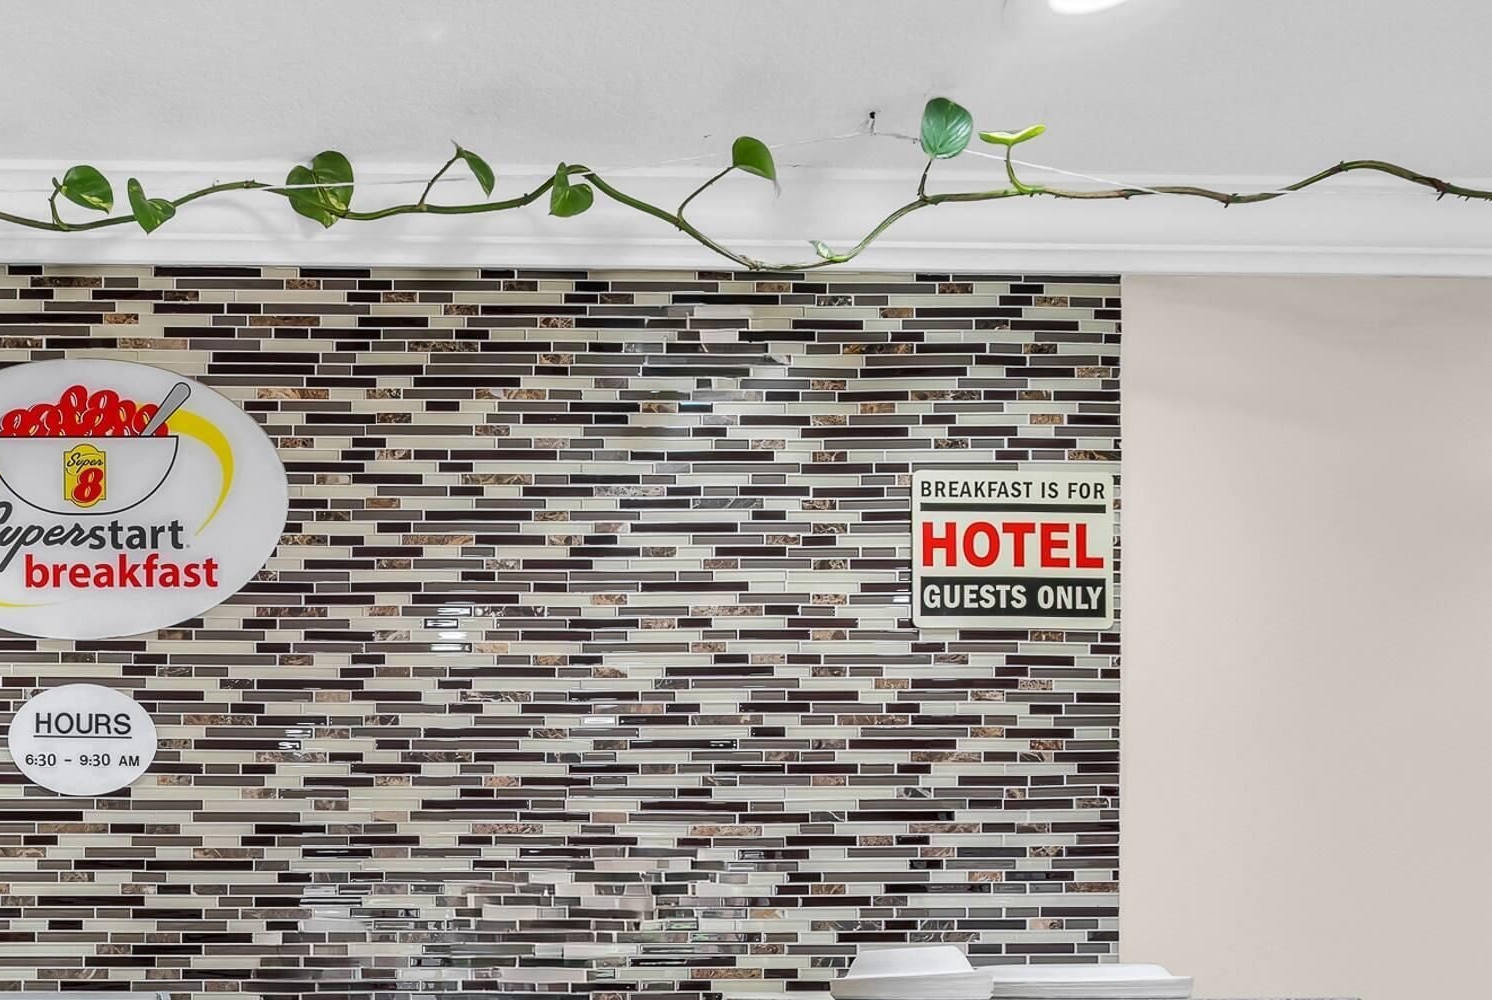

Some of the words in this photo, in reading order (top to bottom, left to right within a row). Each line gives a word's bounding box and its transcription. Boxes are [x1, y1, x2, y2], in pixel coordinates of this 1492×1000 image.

[66, 452, 104, 473] Super
[72, 467, 104, 503] 8
[920, 480, 1033, 499] BREAKFAST
[1040, 481, 1059, 499] IS
[1067, 482, 1106, 500] FOR
[921, 521, 1105, 569] HOTEL
[24, 553, 219, 589] breakfast
[922, 583, 1028, 610] GUESTS
[1037, 585, 1103, 610] ONLY
[35, 712, 132, 735] HOURS
[25, 753, 57, 767] 6:30
[79, 753, 111, 767] 9:30
[118, 755, 140, 767] AM
